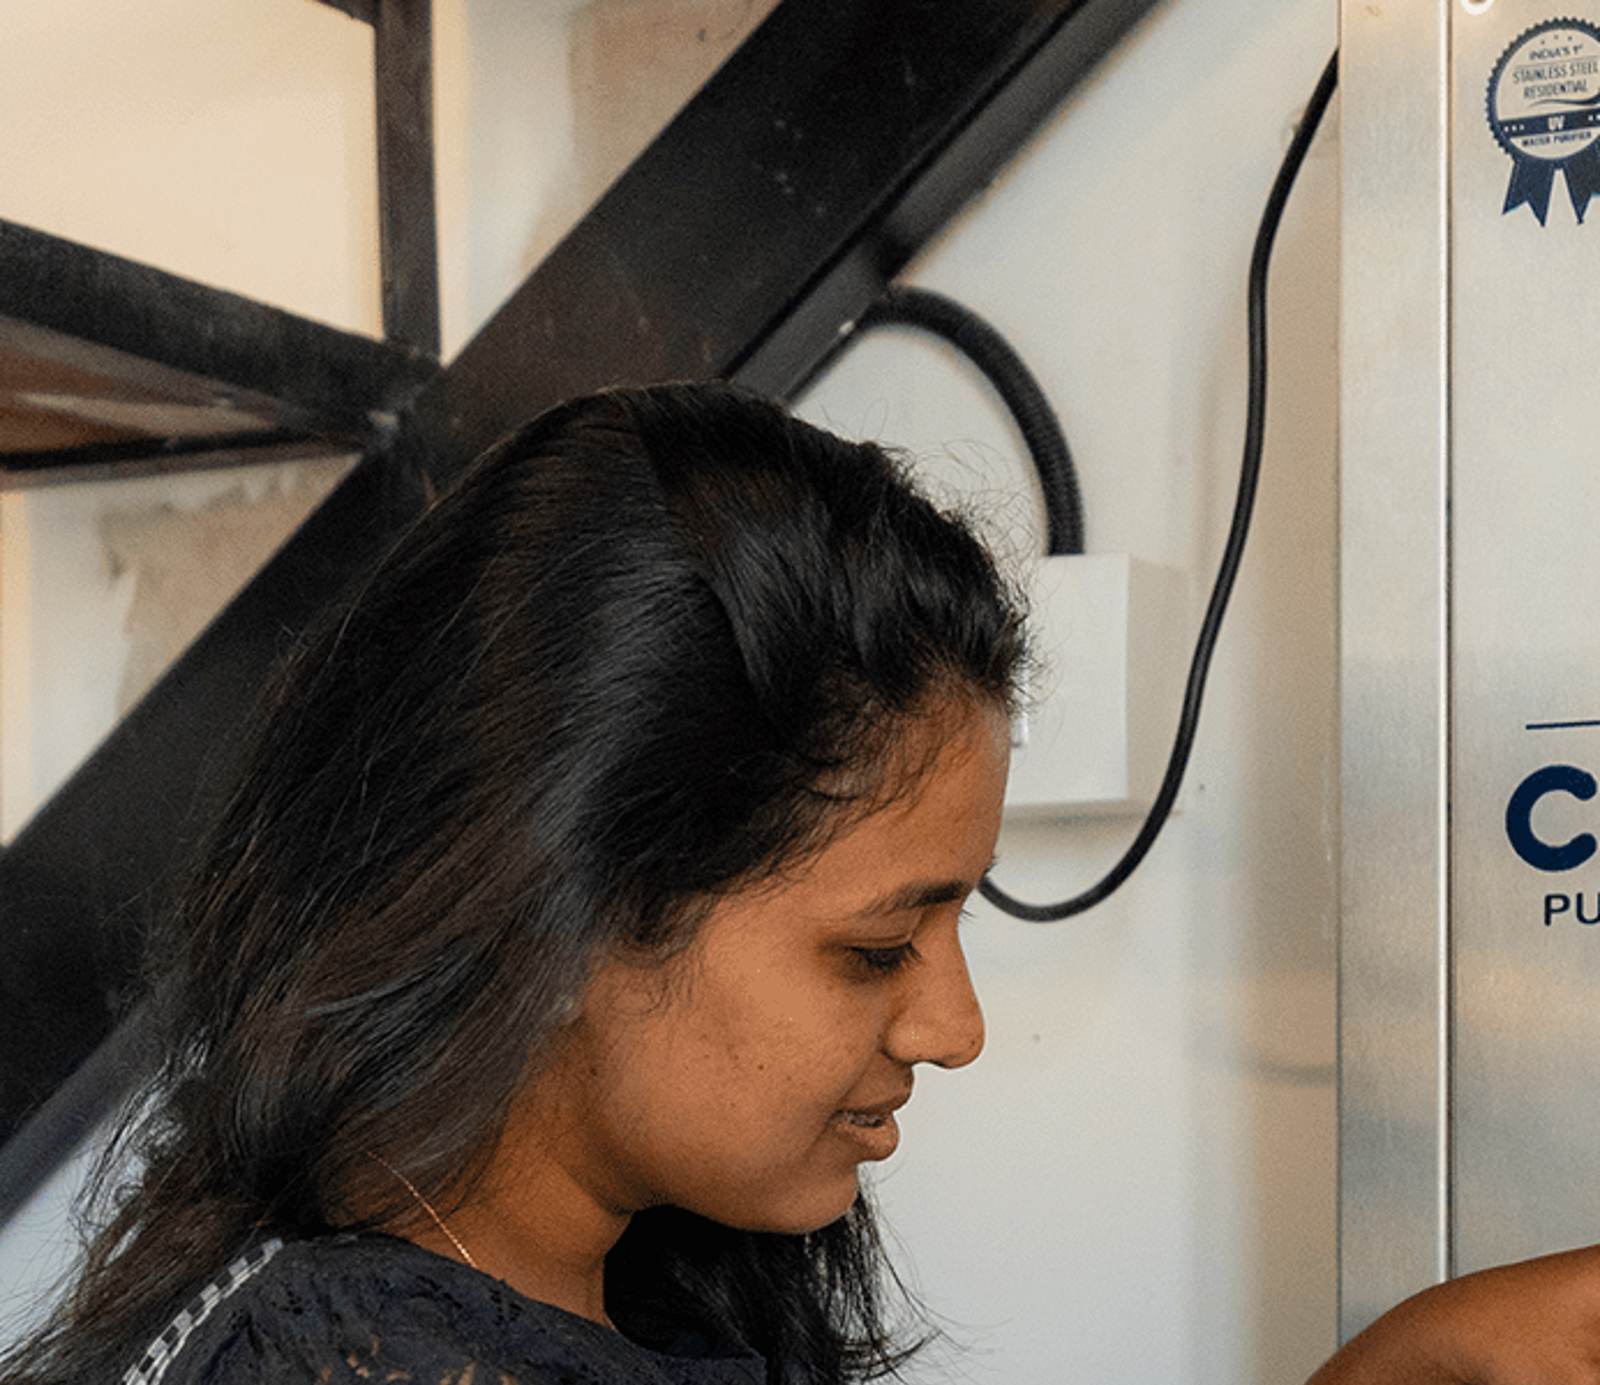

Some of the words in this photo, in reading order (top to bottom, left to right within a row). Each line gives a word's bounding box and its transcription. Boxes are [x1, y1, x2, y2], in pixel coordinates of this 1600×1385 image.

[1513, 65, 1567, 83] STAINLESS
[1570, 61, 1598, 76] STEEL
[1524, 80, 1587, 98] RESIDENTIAL
[1522, 135, 1550, 146] WATER
[1553, 130, 1591, 144] PURIFIER
[1505, 764, 1597, 871] C
[1544, 892, 1600, 926] PU
